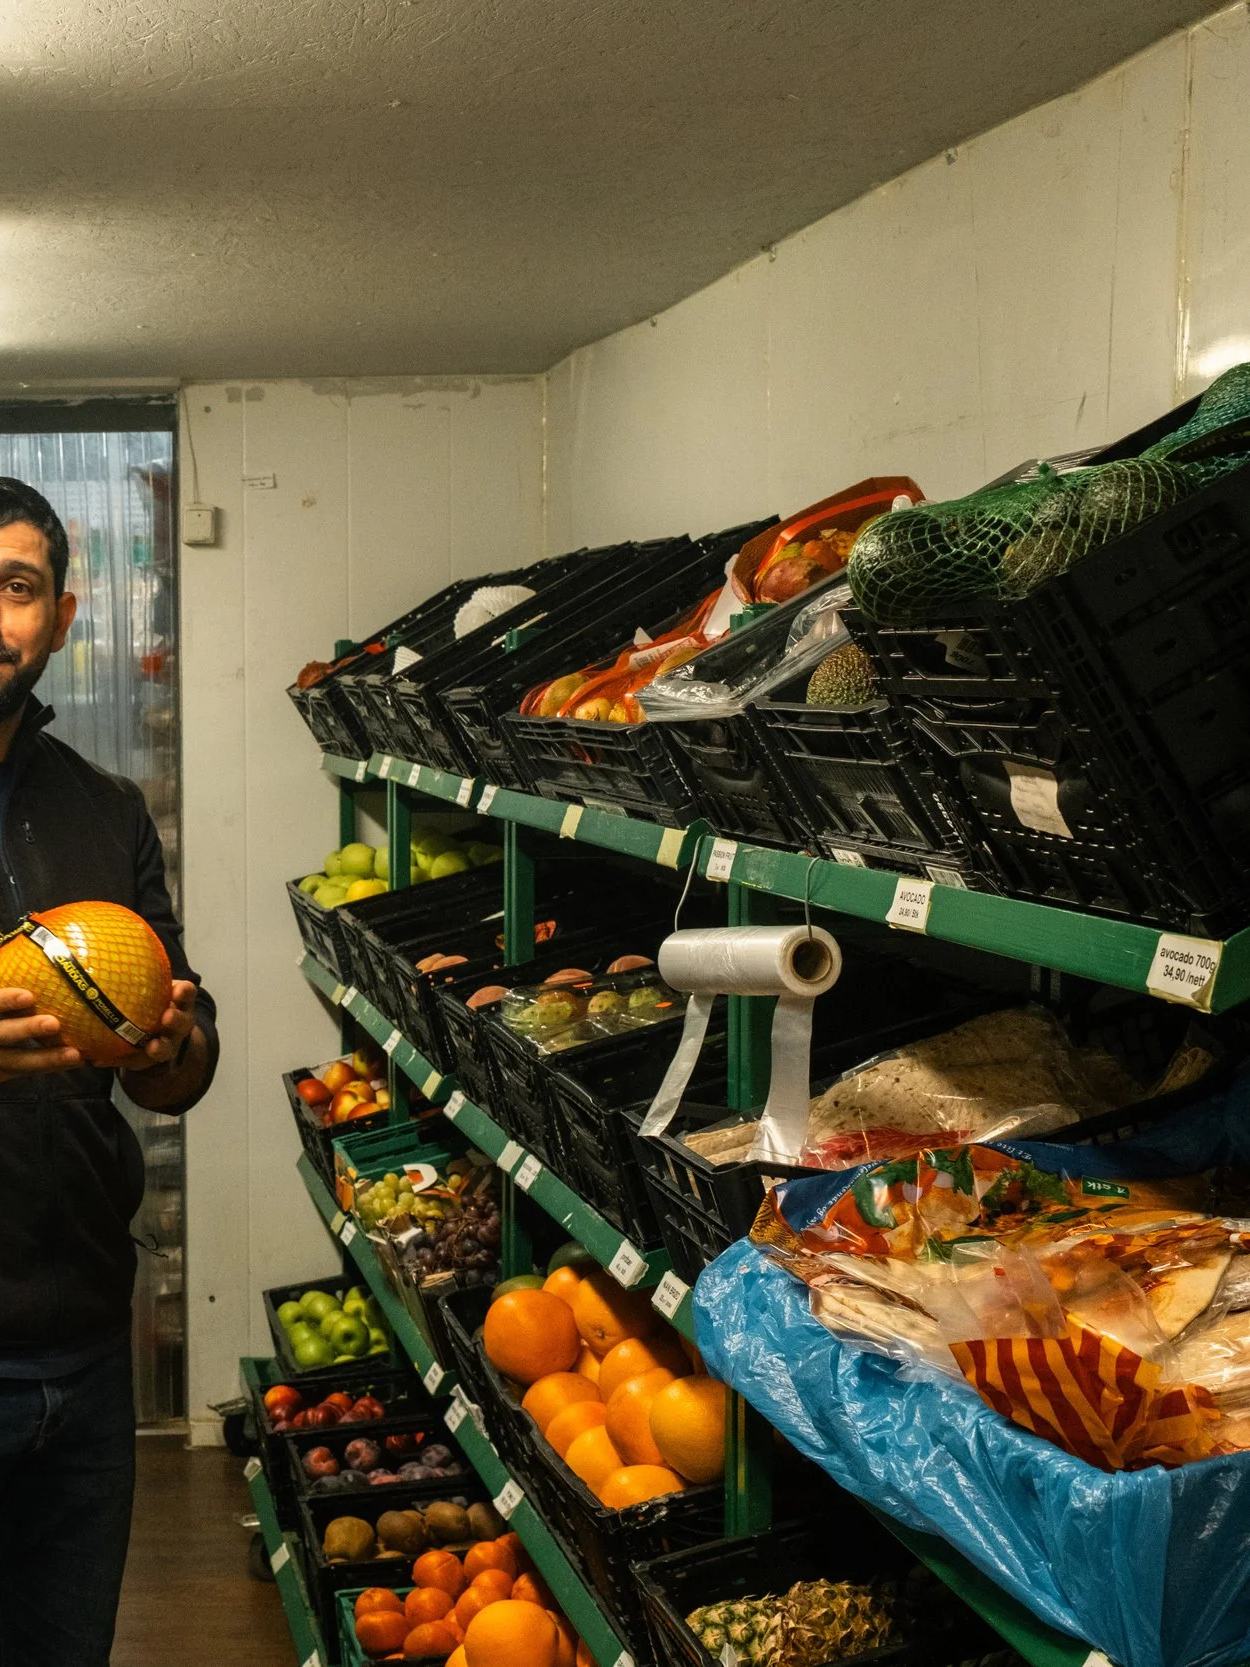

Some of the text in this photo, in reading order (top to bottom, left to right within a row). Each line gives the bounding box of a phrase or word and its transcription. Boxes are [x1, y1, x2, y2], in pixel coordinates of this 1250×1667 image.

[900, 891, 926, 905] AVOCADO
[1160, 947, 1216, 974] avocado 700g
[1163, 964, 1186, 982] 34,90
[95, 998, 120, 1024] POMELO
[1087, 1180, 1111, 1191] stk
